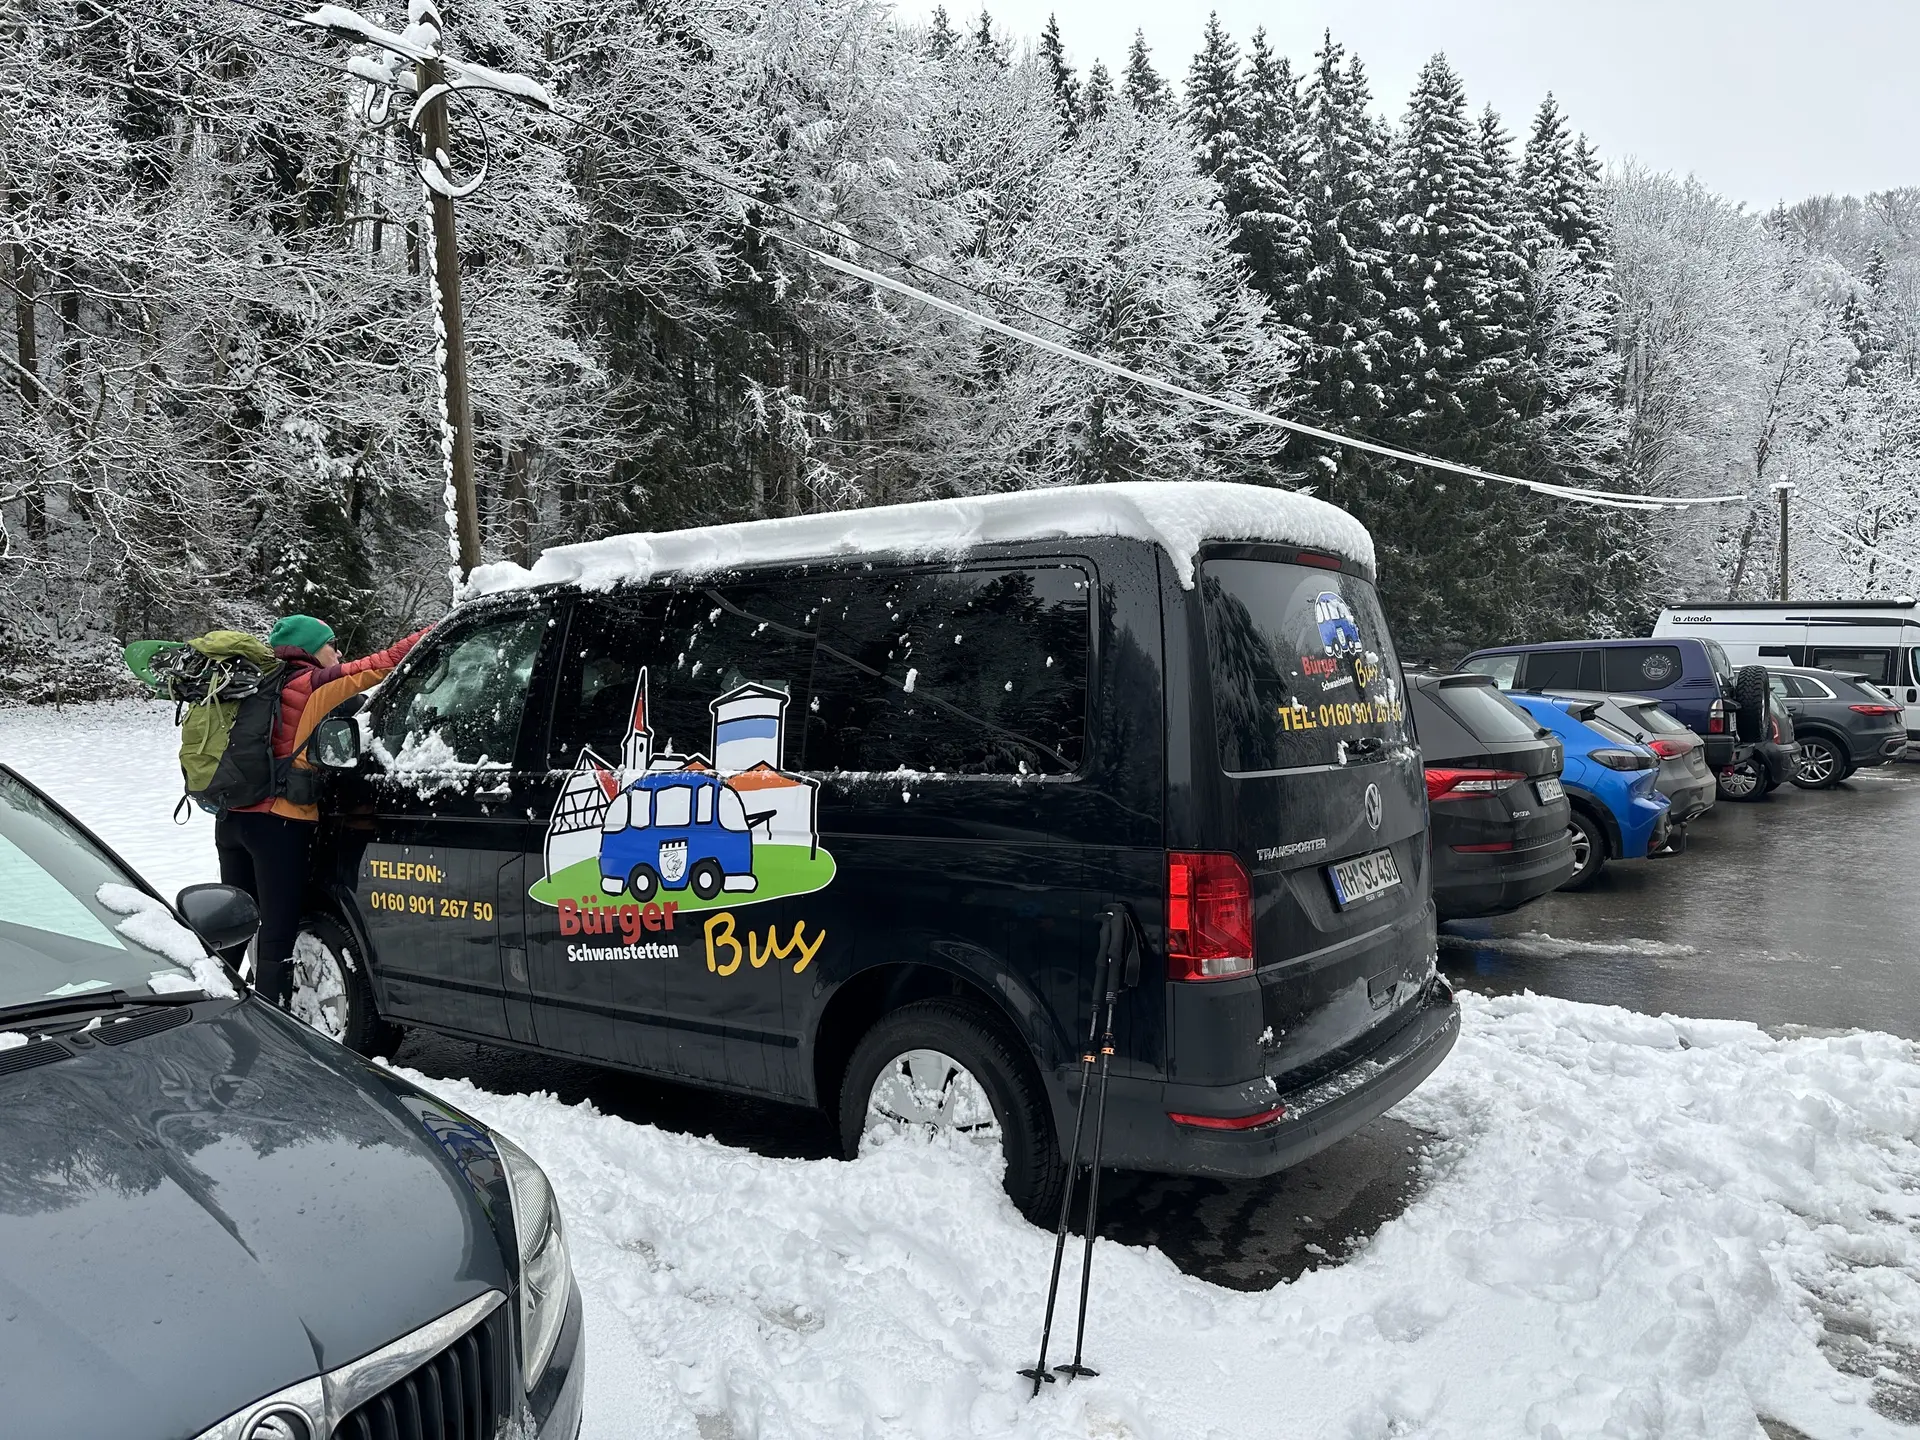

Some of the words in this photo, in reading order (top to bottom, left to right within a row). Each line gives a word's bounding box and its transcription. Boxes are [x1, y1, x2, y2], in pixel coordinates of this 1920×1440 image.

[1672, 614, 1682, 622] la
[1683, 614, 1712, 622] strada
[1301, 655, 1337, 679] Bürger
[1321, 675, 1353, 691] Schwanstetten
[1278, 704, 1317, 731] TEL:
[1319, 703, 1352, 727] 0160
[1354, 702, 1374, 724] 901
[1375, 701, 1391, 723] 267
[1256, 838, 1327, 861] TRANSPORTER
[370, 860, 442, 884] TELEFON:
[1336, 865, 1360, 898] RH
[1359, 859, 1379, 890] SC
[1376, 853, 1398, 883] 430
[371, 891, 405, 912] 0160
[408, 895, 435, 915] 901
[440, 898, 468, 919] 267
[473, 901, 493, 922] 50
[557, 895, 679, 945] Bürger
[567, 941, 679, 962] Schwanstetten
[703, 911, 826, 977] Bus
